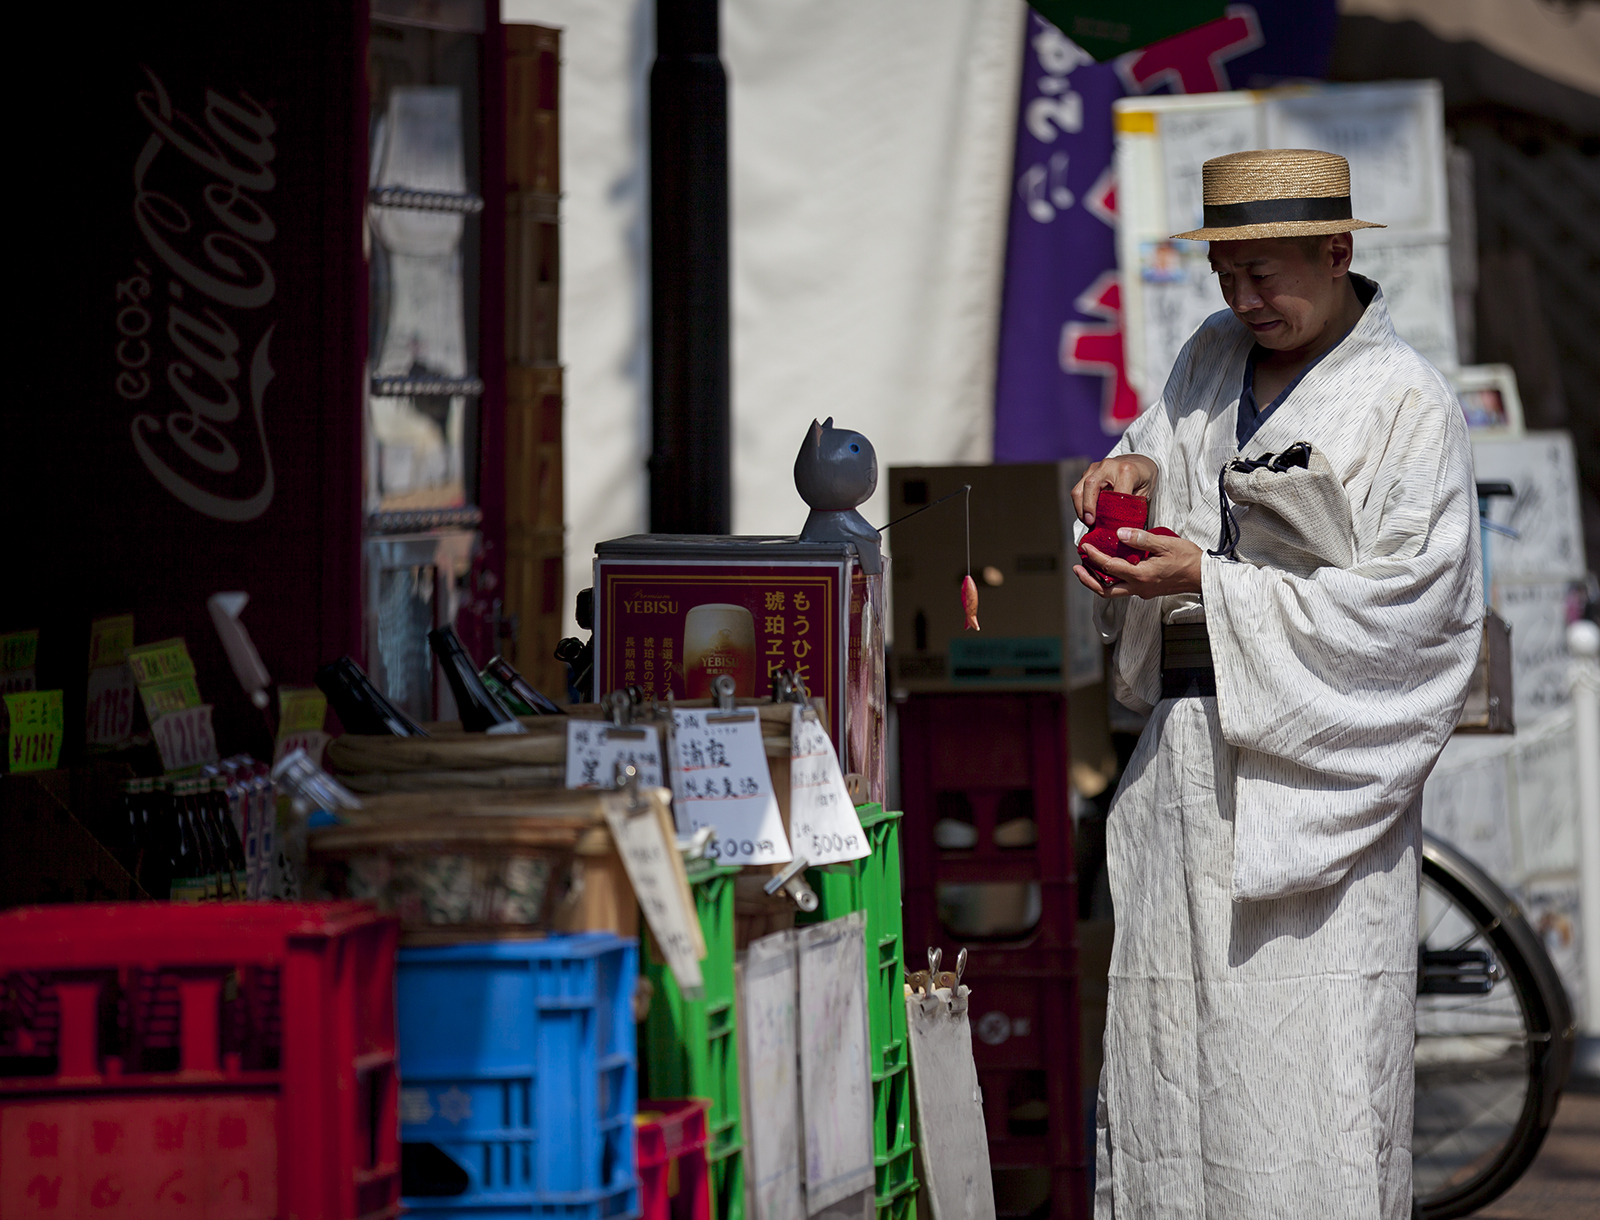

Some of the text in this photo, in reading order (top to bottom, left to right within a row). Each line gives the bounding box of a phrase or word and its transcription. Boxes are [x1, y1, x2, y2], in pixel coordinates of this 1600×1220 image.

[131, 63, 277, 523] Coca-Cola
[629, 588, 671, 600] Premium
[623, 600, 679, 615] YEBISU
[764, 590, 786, 689] 琥珀ヱビ
[701, 656, 739, 668] YEBISU
[709, 837, 775, 859] 500円
[812, 832, 859, 856] 500円
